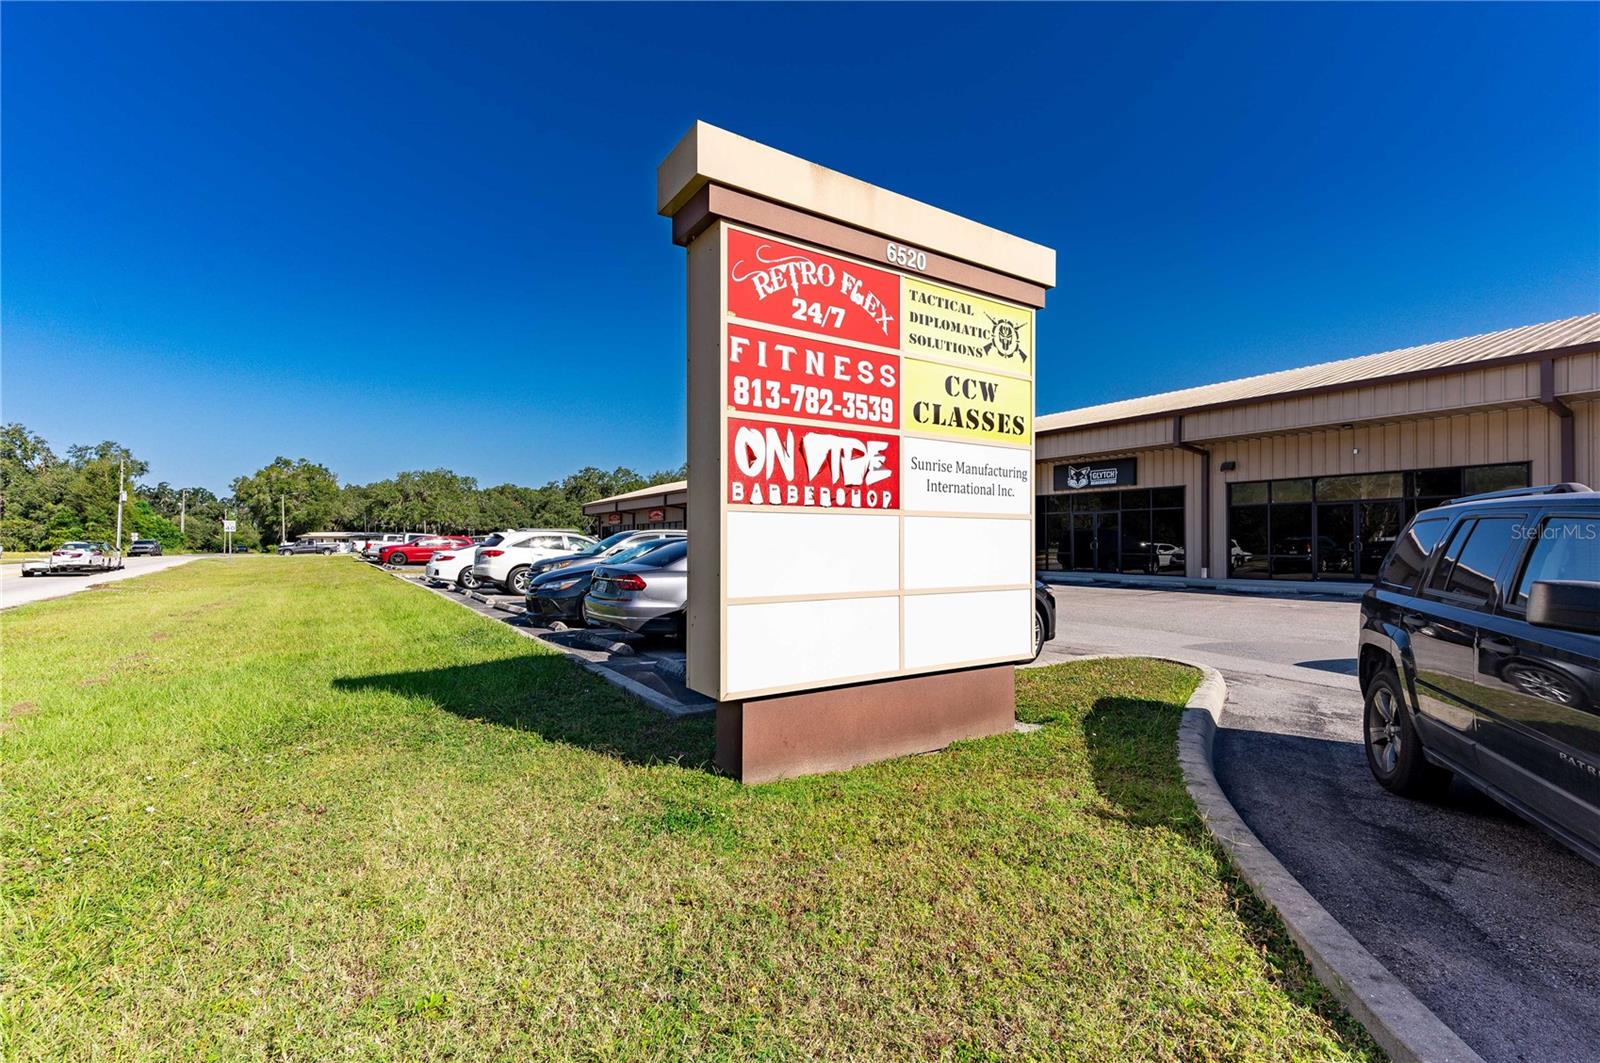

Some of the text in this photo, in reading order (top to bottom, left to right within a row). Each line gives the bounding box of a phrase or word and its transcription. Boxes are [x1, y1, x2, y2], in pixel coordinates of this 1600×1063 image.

[886, 242, 927, 271] 6520
[736, 254, 894, 336] RETRO FLEX
[909, 289, 974, 316] TACTICAL
[791, 297, 846, 328] 24/7
[909, 311, 991, 340] DIPLOMATIC
[908, 332, 983, 358] SOLUTIONS
[730, 335, 897, 387] FITNESS
[733, 375, 894, 423] 813-782-3539
[944, 375, 998, 403] CCW
[912, 401, 1025, 436] CLASSES
[734, 426, 795, 482] ON
[911, 456, 1028, 482] Sunrise Manufacturing
[926, 479, 1015, 497] International Inc.
[1559, 751, 1600, 777] PATR
